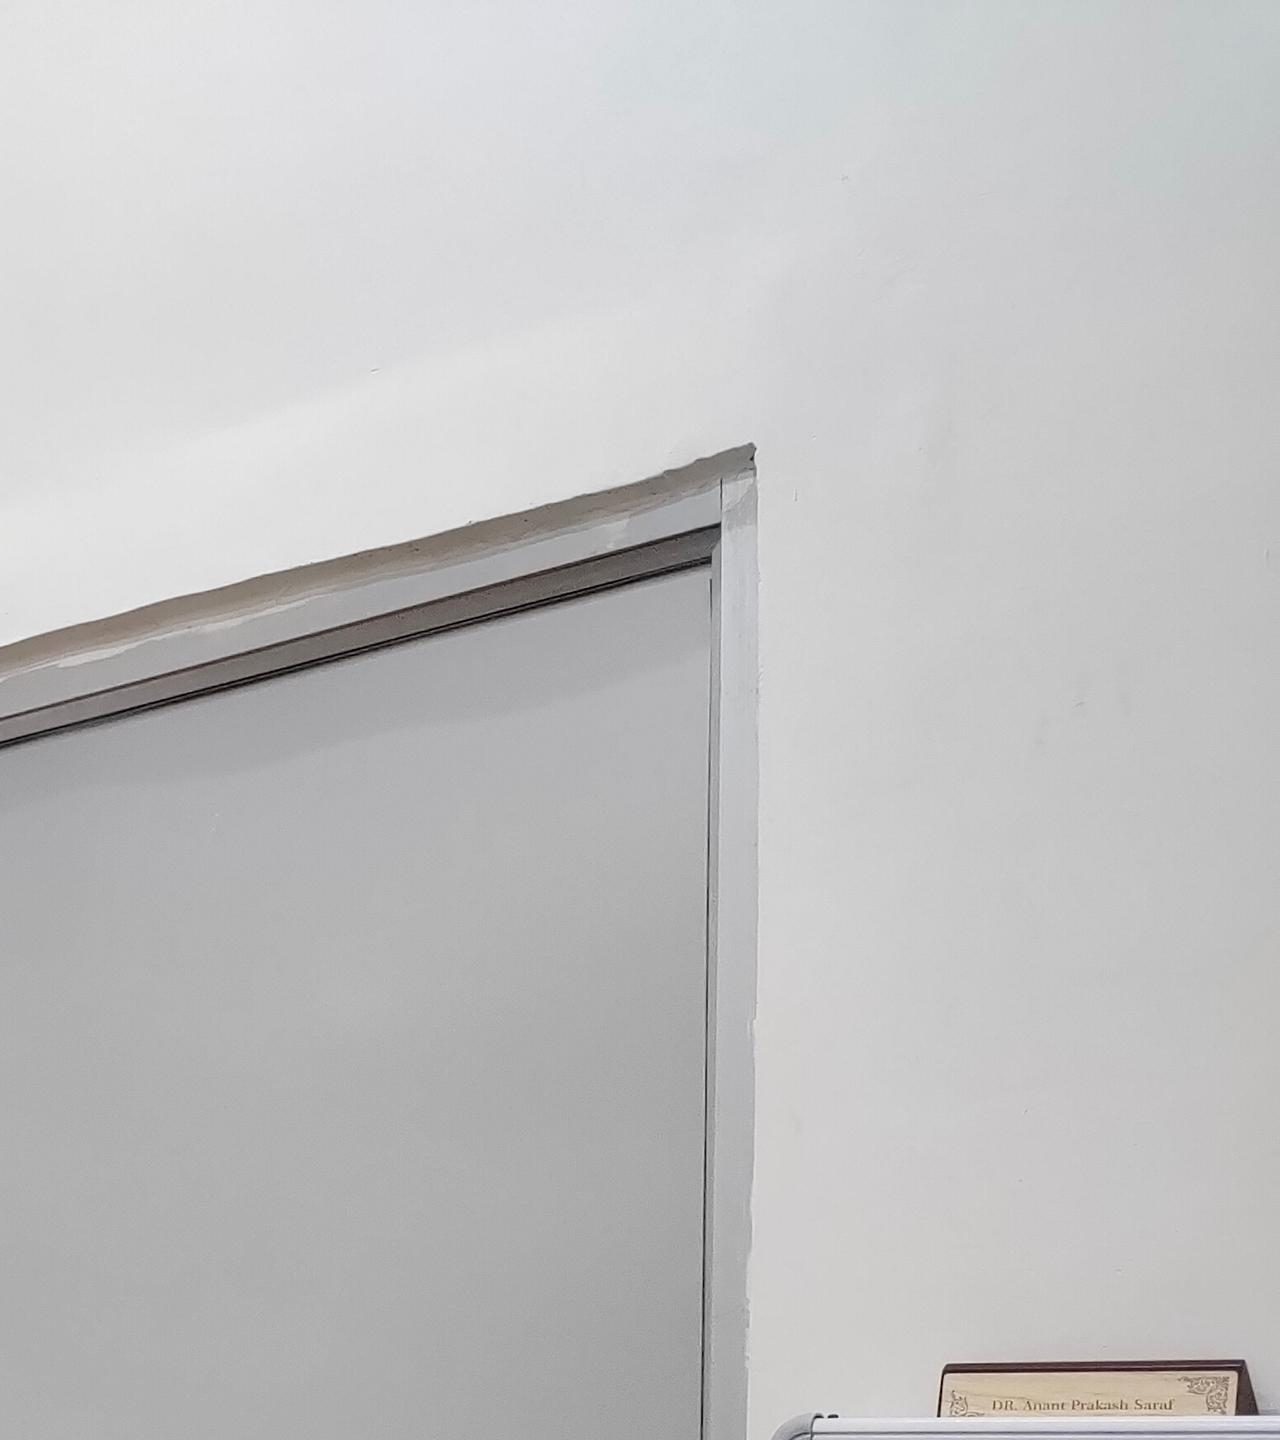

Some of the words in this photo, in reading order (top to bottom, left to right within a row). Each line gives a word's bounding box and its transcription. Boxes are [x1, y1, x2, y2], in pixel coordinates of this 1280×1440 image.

[992, 1400, 1018, 1412] DR.
[1022, 1400, 1067, 1411] Anant
[1071, 1399, 1129, 1411] Prakash
[1134, 1399, 1176, 1411] Saraf
